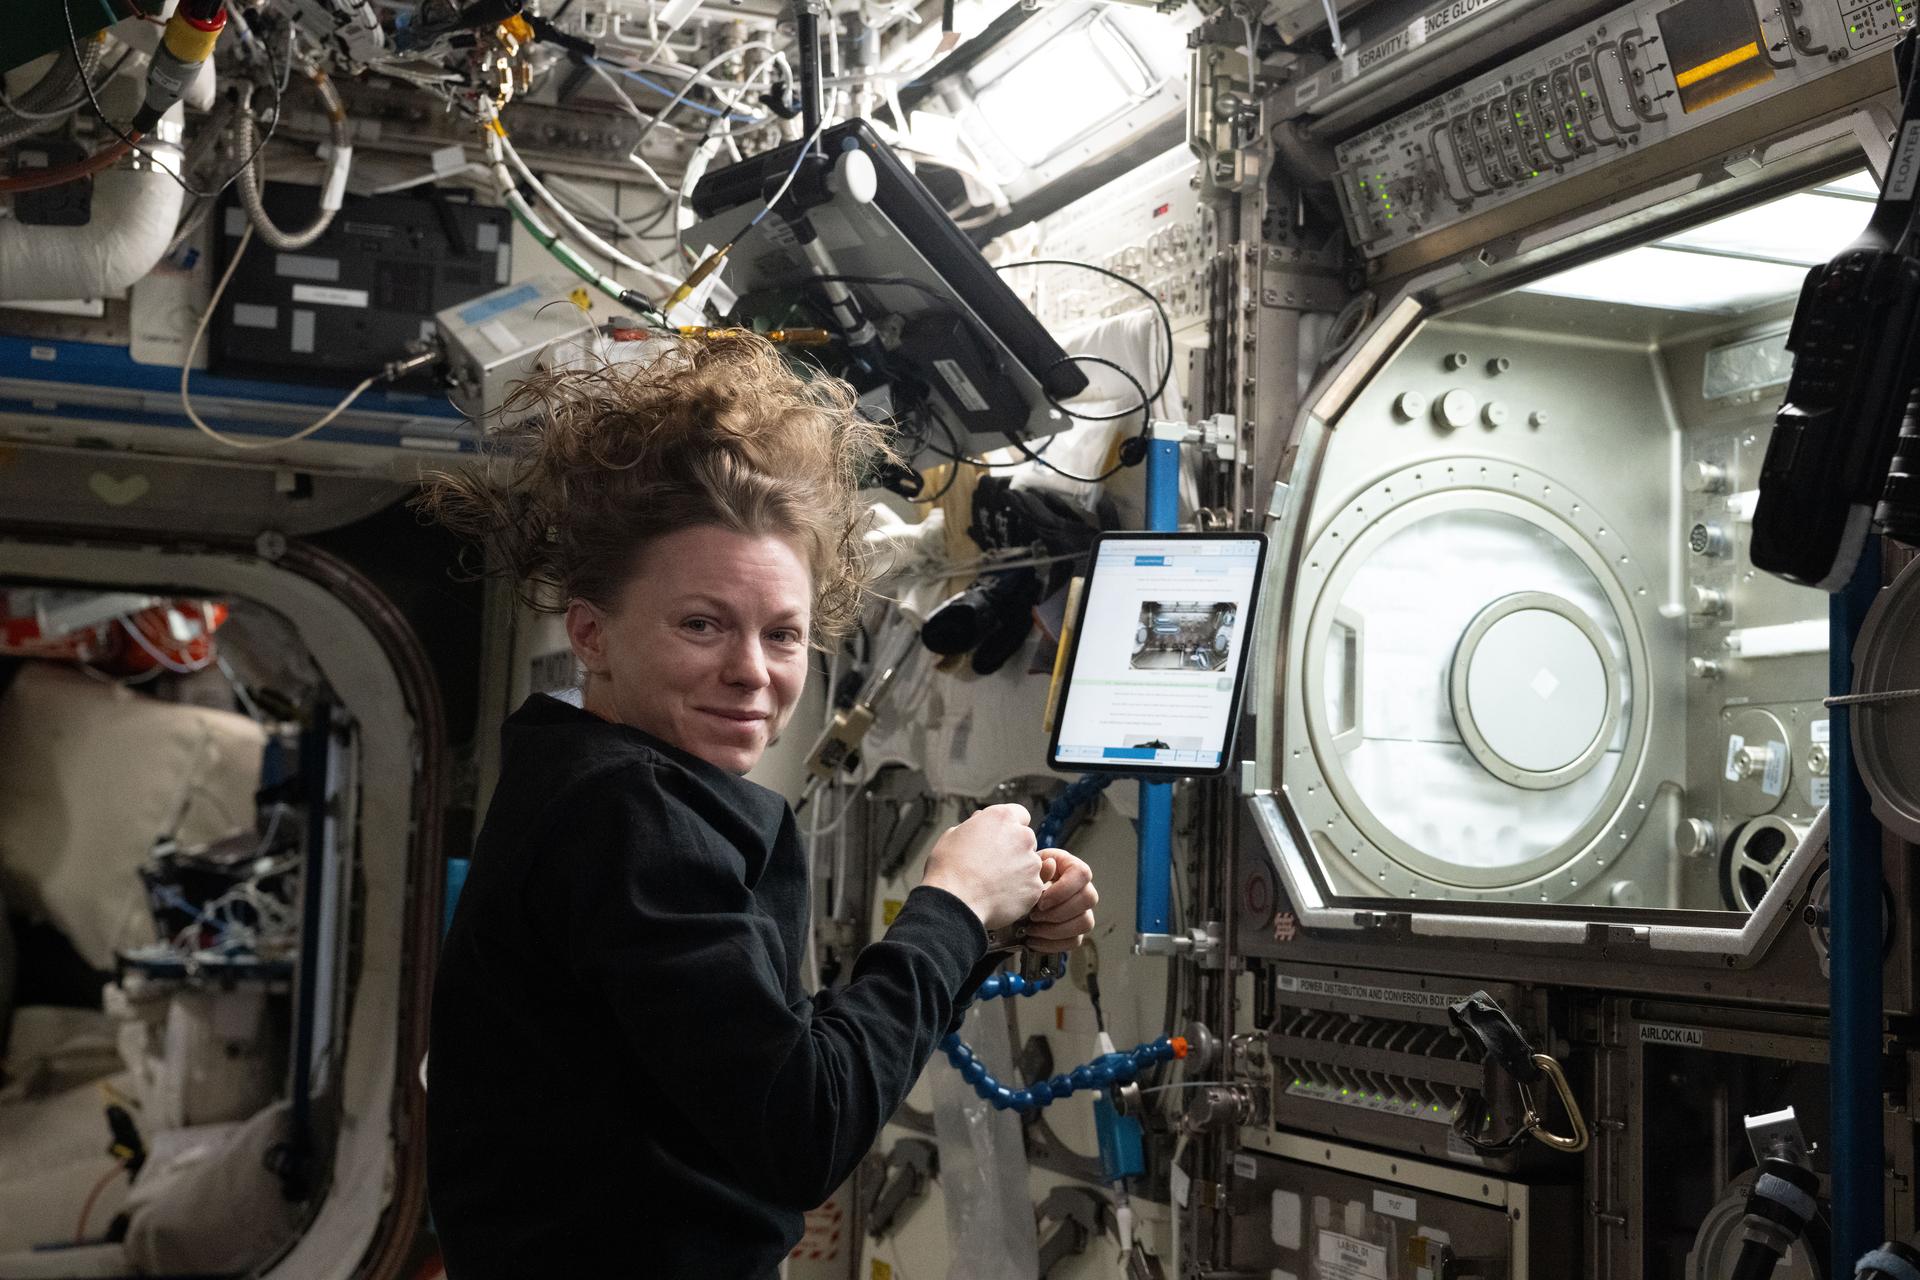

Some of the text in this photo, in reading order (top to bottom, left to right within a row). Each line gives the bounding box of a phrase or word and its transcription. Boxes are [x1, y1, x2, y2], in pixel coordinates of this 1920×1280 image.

[1893, 126, 1920, 193] FLOATER
[1300, 980, 1323, 992] POWER
[1324, 982, 1368, 999] DISTRIBUTION
[1369, 989, 1383, 1000] AND
[1384, 990, 1428, 1005] CONVERSION
[1429, 994, 1446, 1006] BOX
